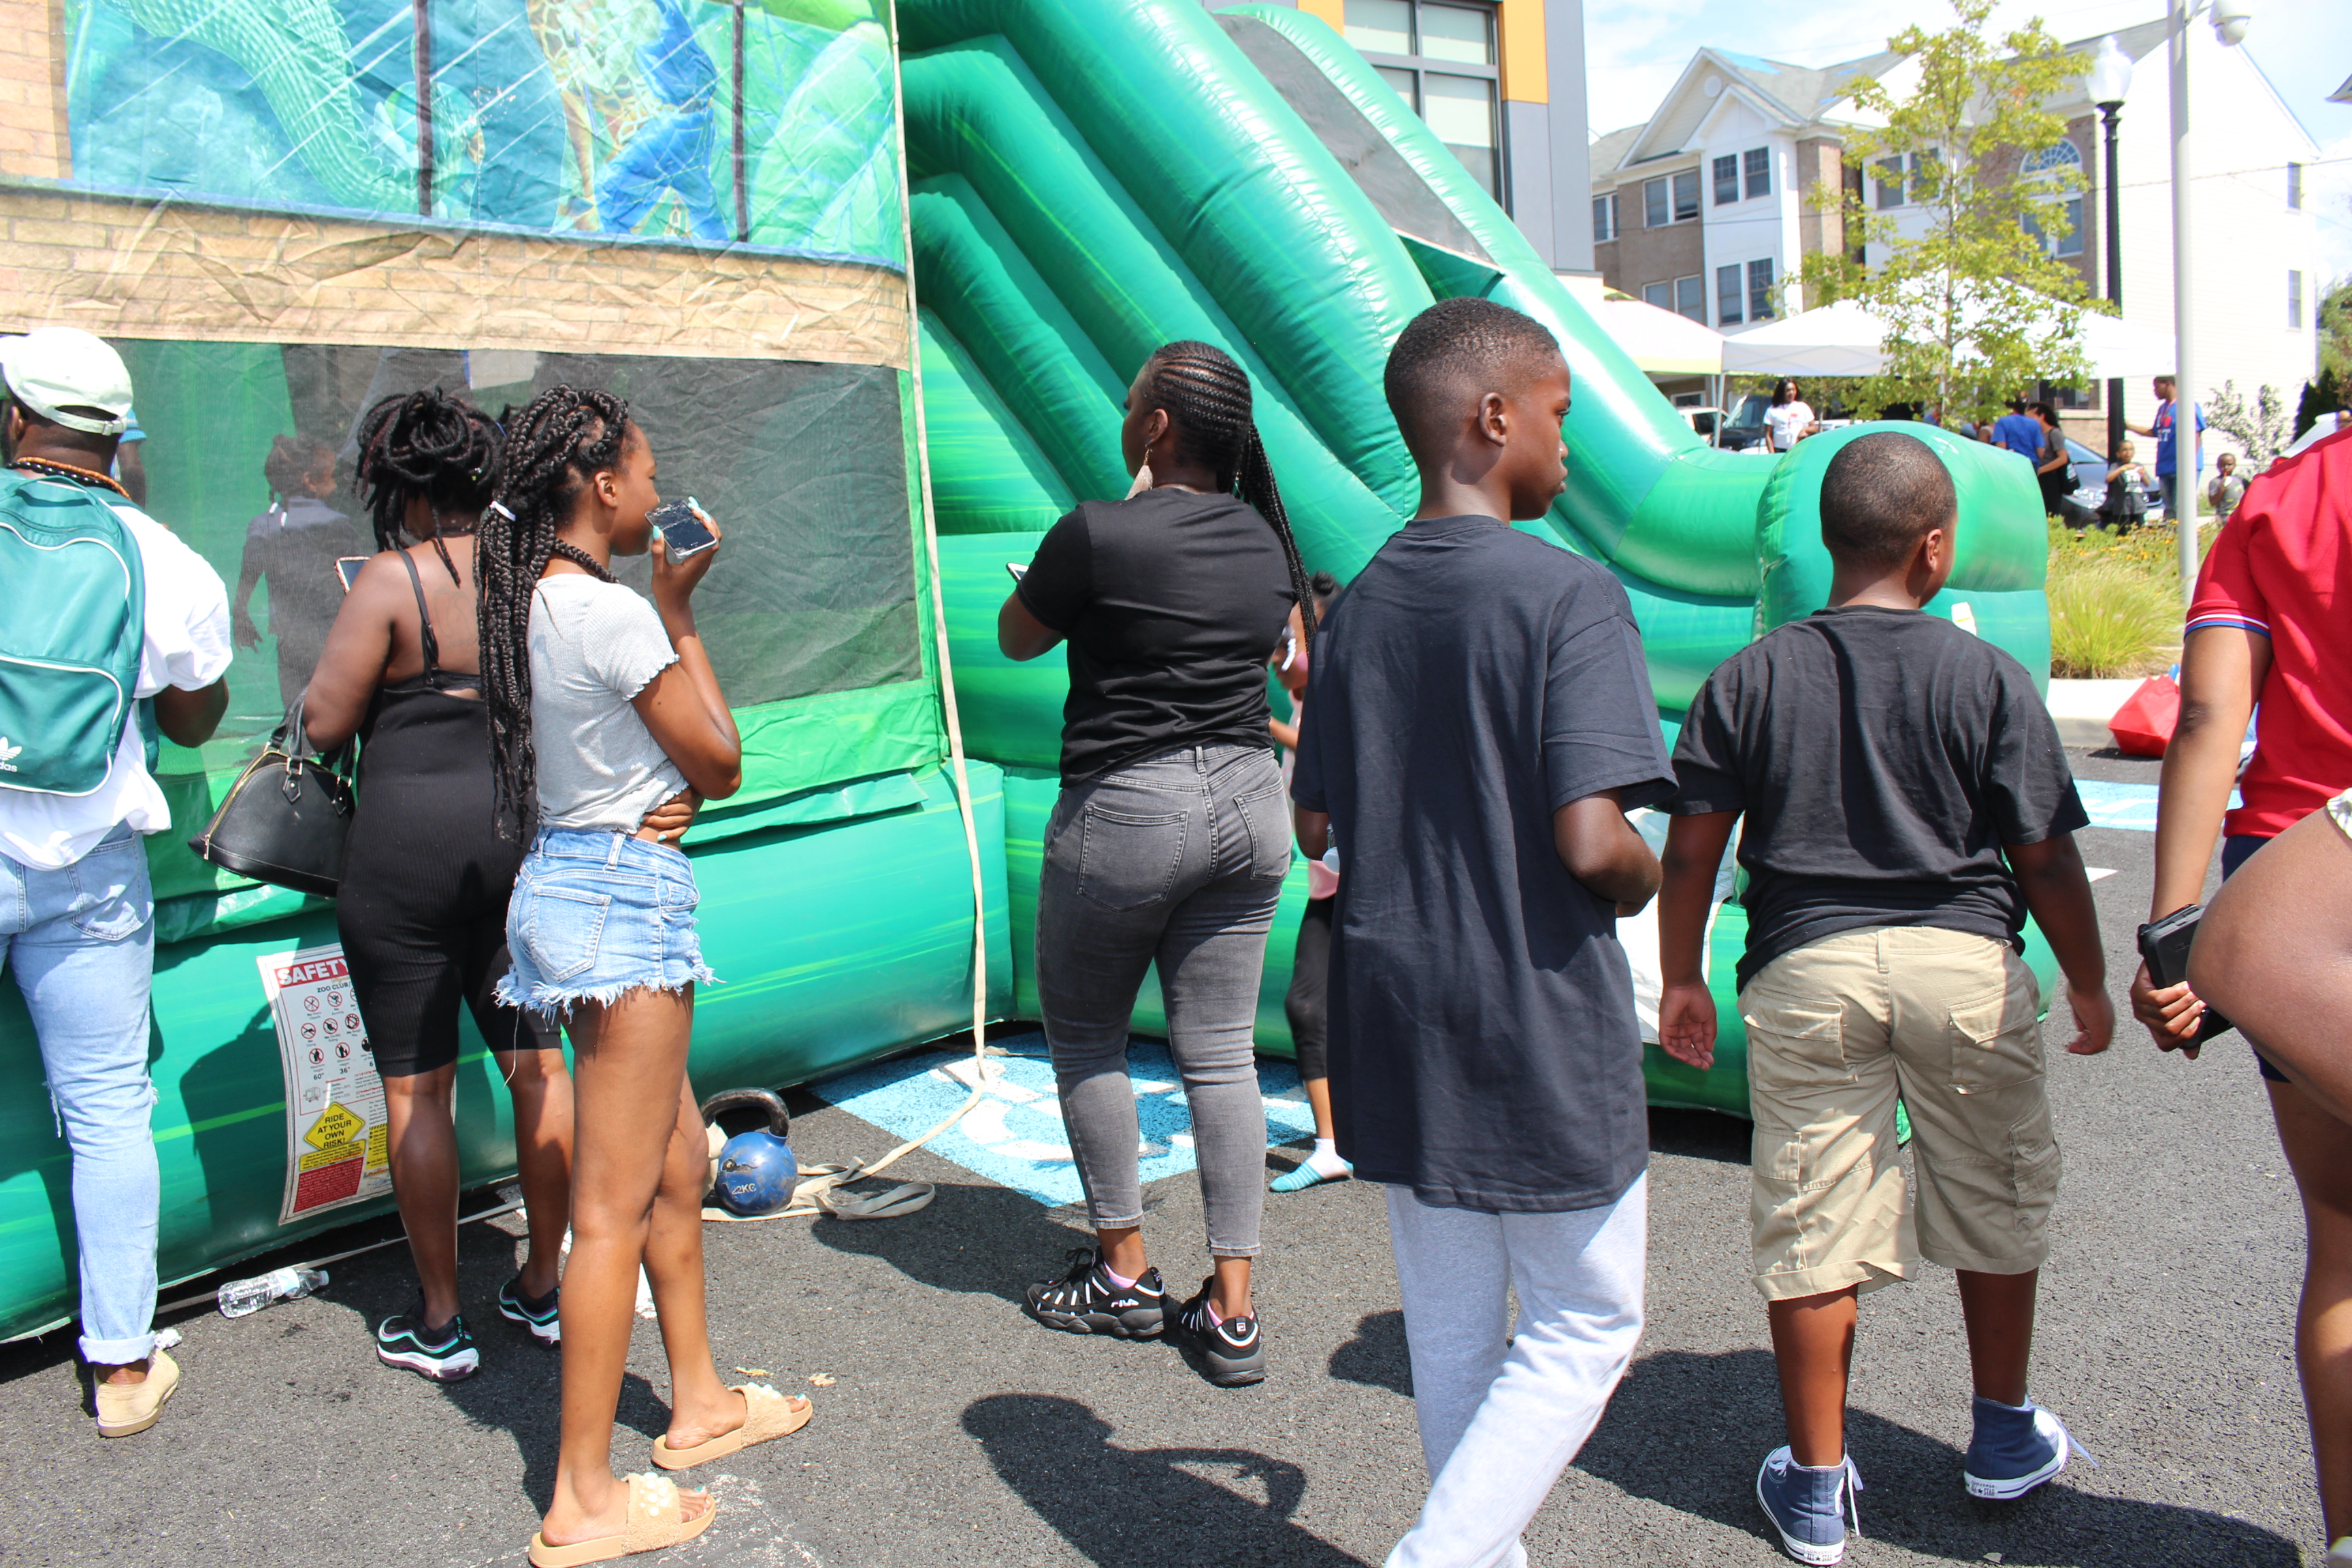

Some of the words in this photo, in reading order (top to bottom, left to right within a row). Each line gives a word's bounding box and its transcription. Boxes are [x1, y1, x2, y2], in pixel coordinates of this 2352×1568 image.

[325, 1113, 344, 1124] RIDE
[317, 1126, 328, 1134] AT
[329, 1120, 352, 1130] YOUR
[325, 1130, 344, 1140] OWN
[323, 1137, 346, 1149] RISK!
[1111, 1298, 1139, 1307] FILA
[1971, 1480, 1995, 1488] CONVERSE
[1984, 1488, 1995, 1497] STAR
[1822, 1554, 1832, 1562] STAR
